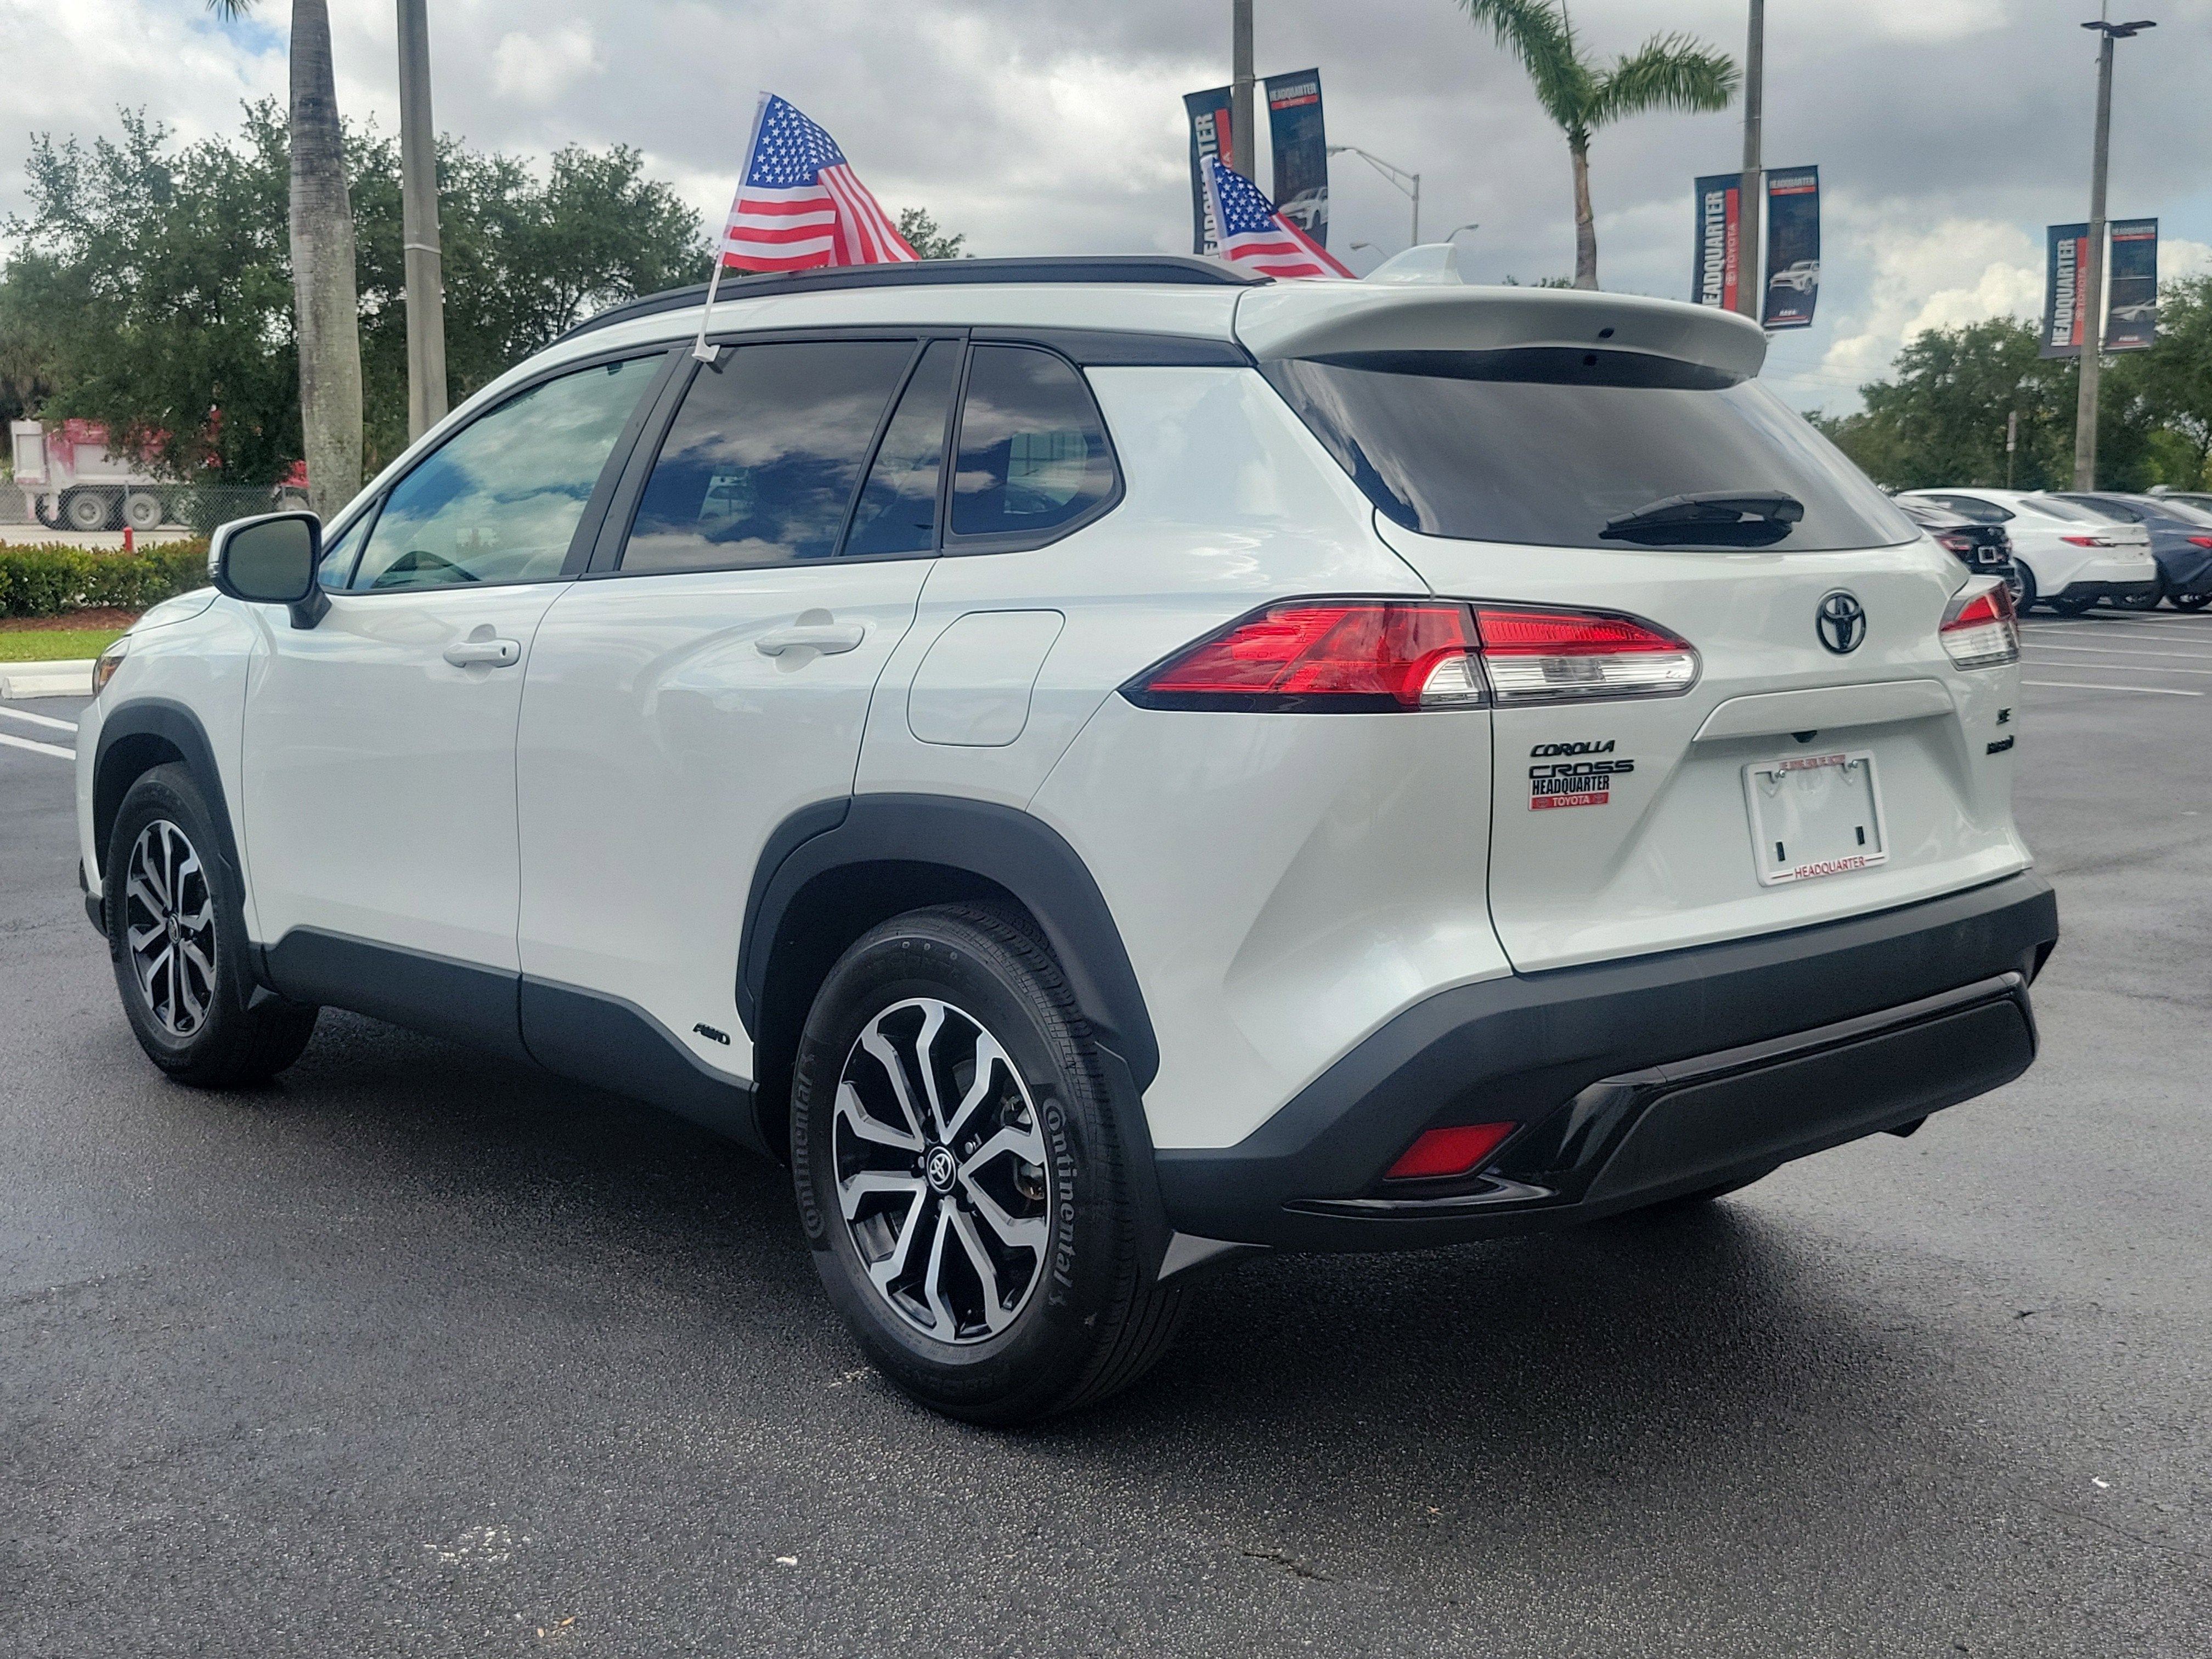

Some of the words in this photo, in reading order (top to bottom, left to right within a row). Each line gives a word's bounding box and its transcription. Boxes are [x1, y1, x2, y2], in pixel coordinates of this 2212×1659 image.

[1727, 222, 1737, 270] TOYOTA
[2050, 239, 2075, 347] HEADQUARTER
[1530, 739, 1615, 757] COROLLA
[1528, 759, 1634, 779] CROSS
[1532, 775, 1610, 795] HEADQUARTER
[1552, 795, 1590, 807] TOYOTA
[1794, 856, 1865, 879] HEADQUARTER
[1042, 1097, 1079, 1288] Continental
